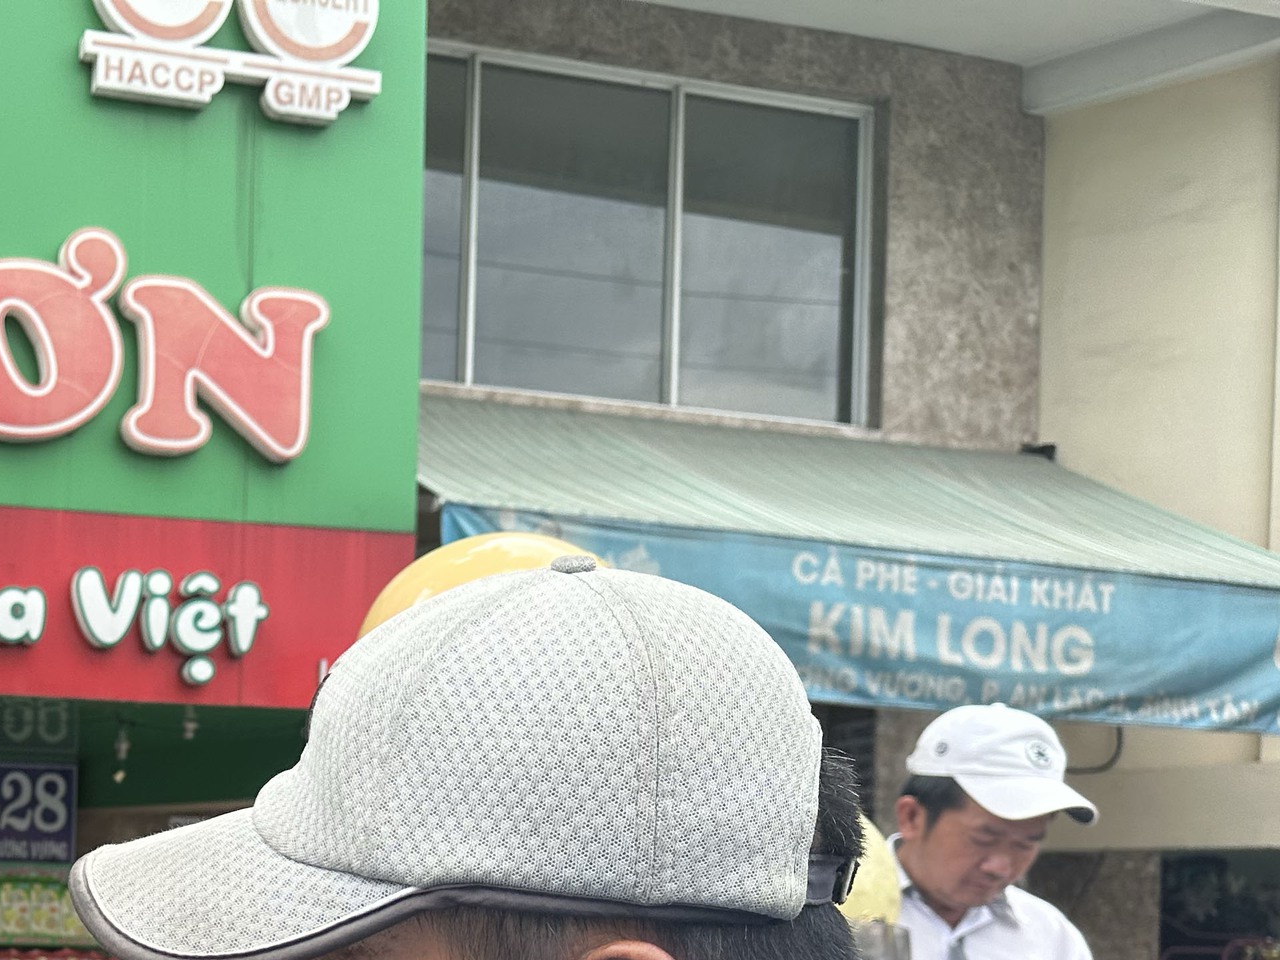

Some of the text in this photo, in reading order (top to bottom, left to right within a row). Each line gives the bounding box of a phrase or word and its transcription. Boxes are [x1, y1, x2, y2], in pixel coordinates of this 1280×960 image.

[104, 56, 217, 93] HACCP
[273, 79, 342, 111] GMP
[1031, 573, 1117, 614] KHÁT
[70, 568, 269, 686] Việt
[807, 601, 1096, 677] KIM LONG
